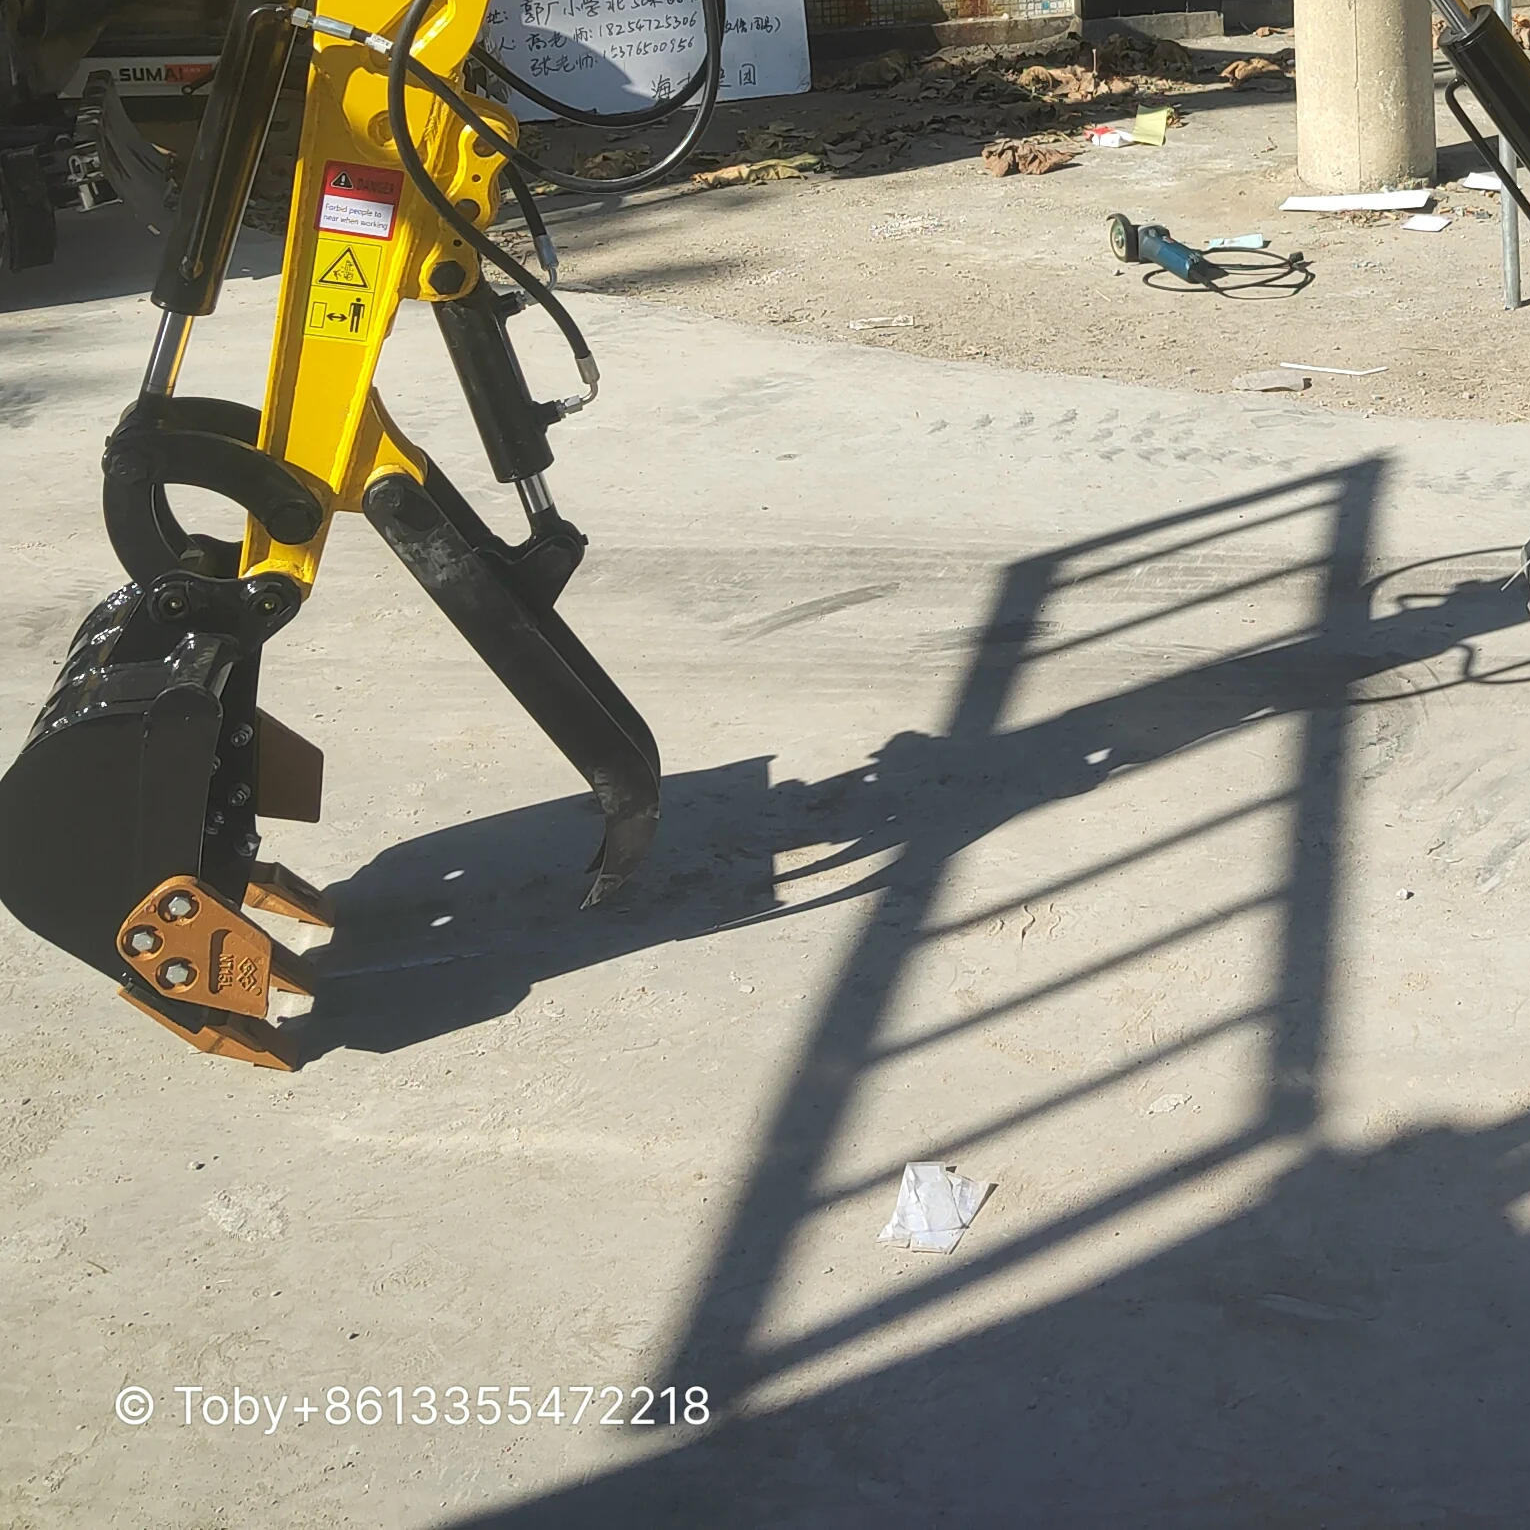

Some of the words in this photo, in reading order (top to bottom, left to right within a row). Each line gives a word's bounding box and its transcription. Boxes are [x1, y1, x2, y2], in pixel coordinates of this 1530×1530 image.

[349, 207, 373, 217] people
[323, 214, 340, 222] near
[340, 216, 359, 226] when
[360, 220, 389, 231] working
